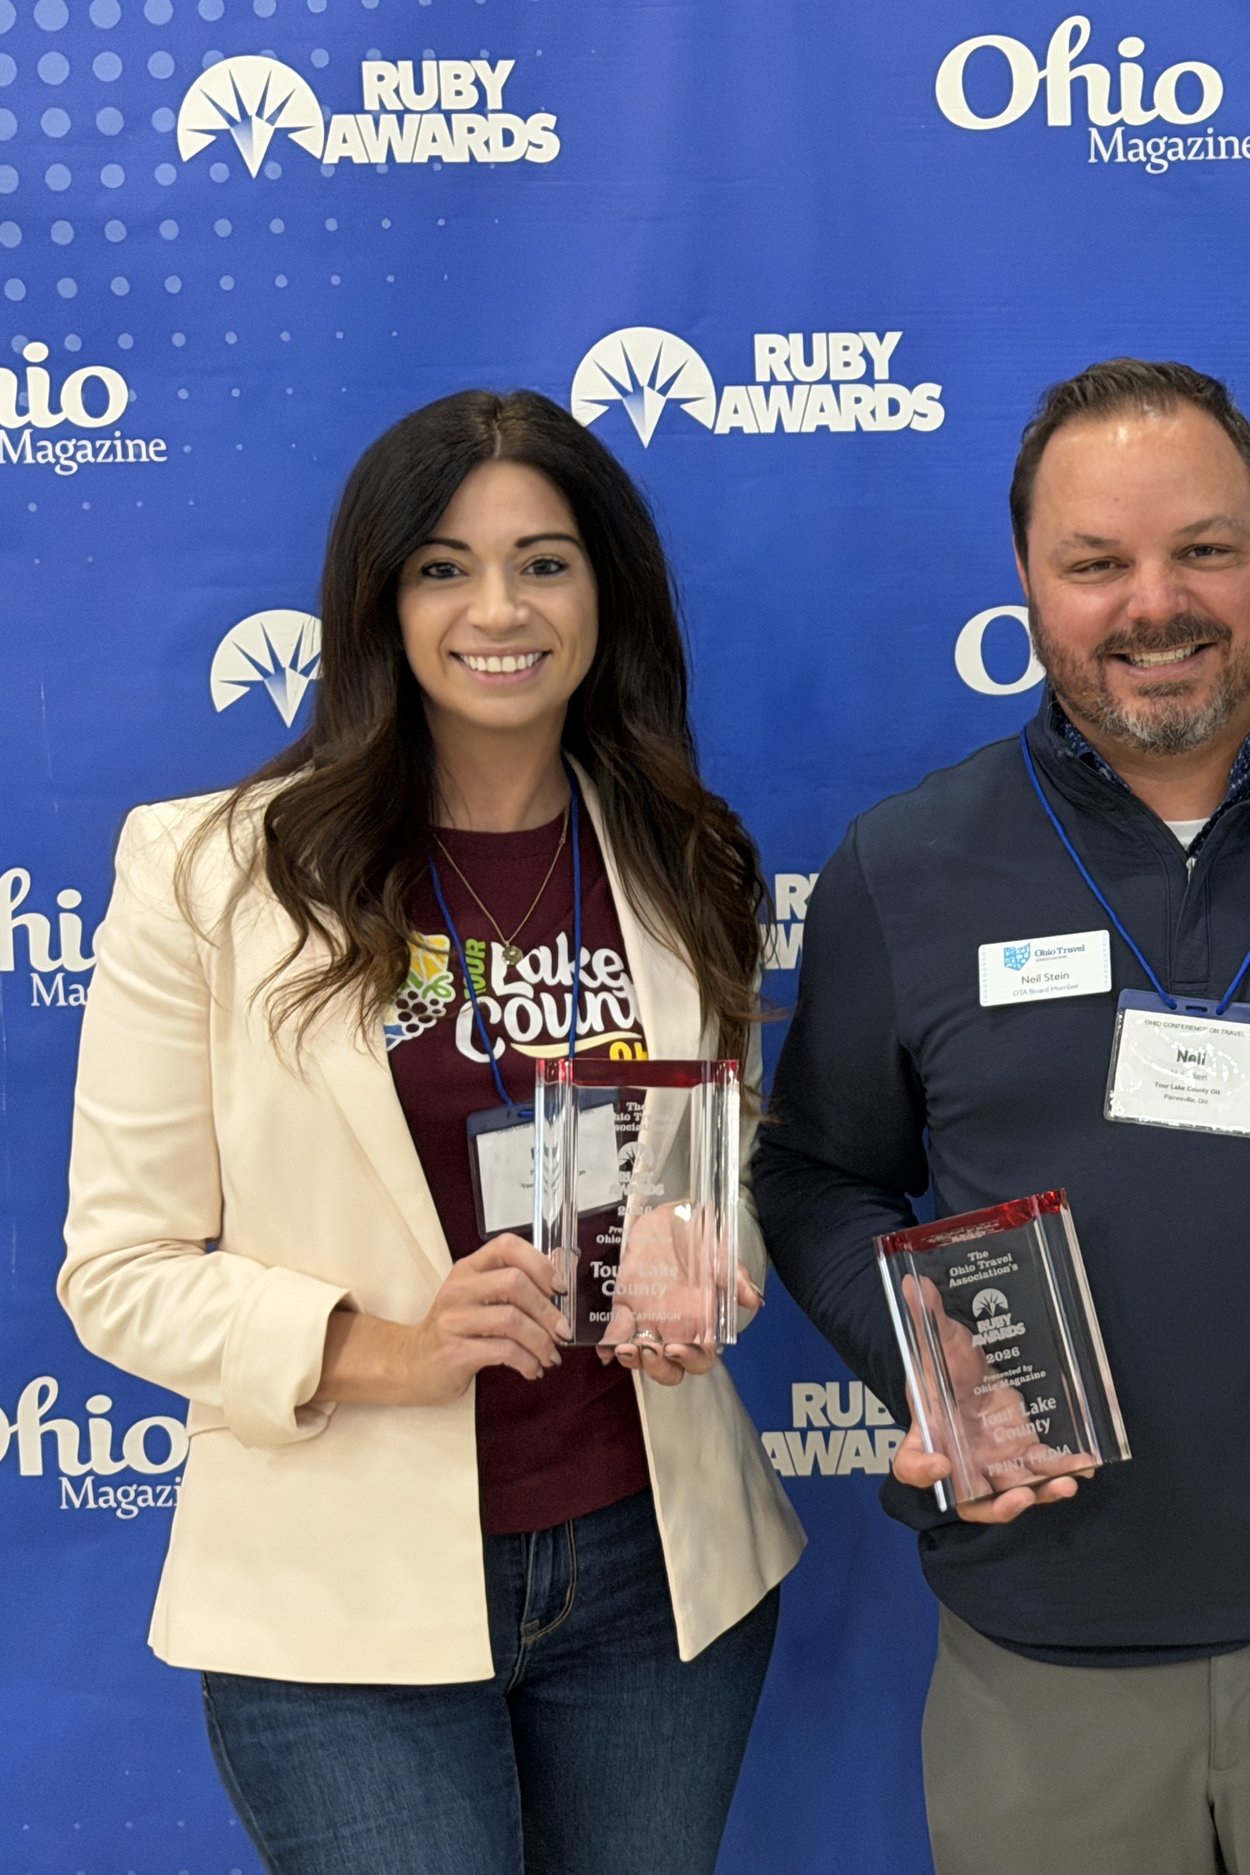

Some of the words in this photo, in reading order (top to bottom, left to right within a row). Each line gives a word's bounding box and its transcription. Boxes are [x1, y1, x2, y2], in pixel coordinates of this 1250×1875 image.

[361, 60, 516, 112] RUBY
[936, 15, 1223, 130] Ohio
[323, 113, 561, 164] AWARDS
[753, 331, 903, 383] RUBY
[0, 342, 129, 429] io
[714, 383, 945, 435] AWARDS
[0, 429, 168, 476] Magazine
[491, 931, 624, 998] Lake
[1034, 948, 1056, 957] Ohio
[1056, 944, 1085, 955] Travel
[1021, 973, 1041, 984] Neil
[1043, 971, 1070, 982] Stein
[455, 972, 643, 1063] Coun
[596, 1234, 621, 1244] Ohio
[589, 1261, 621, 1279] Tou
[949, 1265, 976, 1277] Ohio
[977, 1252, 1013, 1270] Travel
[967, 1250, 990, 1262] The
[948, 1263, 1019, 1288] Association's
[972, 1322, 1026, 1348] AWARDS
[976, 1312, 1012, 1333] RUBY
[986, 1346, 1021, 1364] 2026
[1023, 1364, 1033, 1373] by
[973, 1382, 998, 1396] Ohio
[1000, 1370, 1047, 1387] Magazine
[791, 1380, 895, 1428] RUB
[977, 1408, 1014, 1428] Tour
[1019, 1396, 1057, 1418] Lake
[993, 1417, 1051, 1443] County
[761, 1429, 906, 1477] AWAR
[58, 1476, 182, 1520] Magazi
